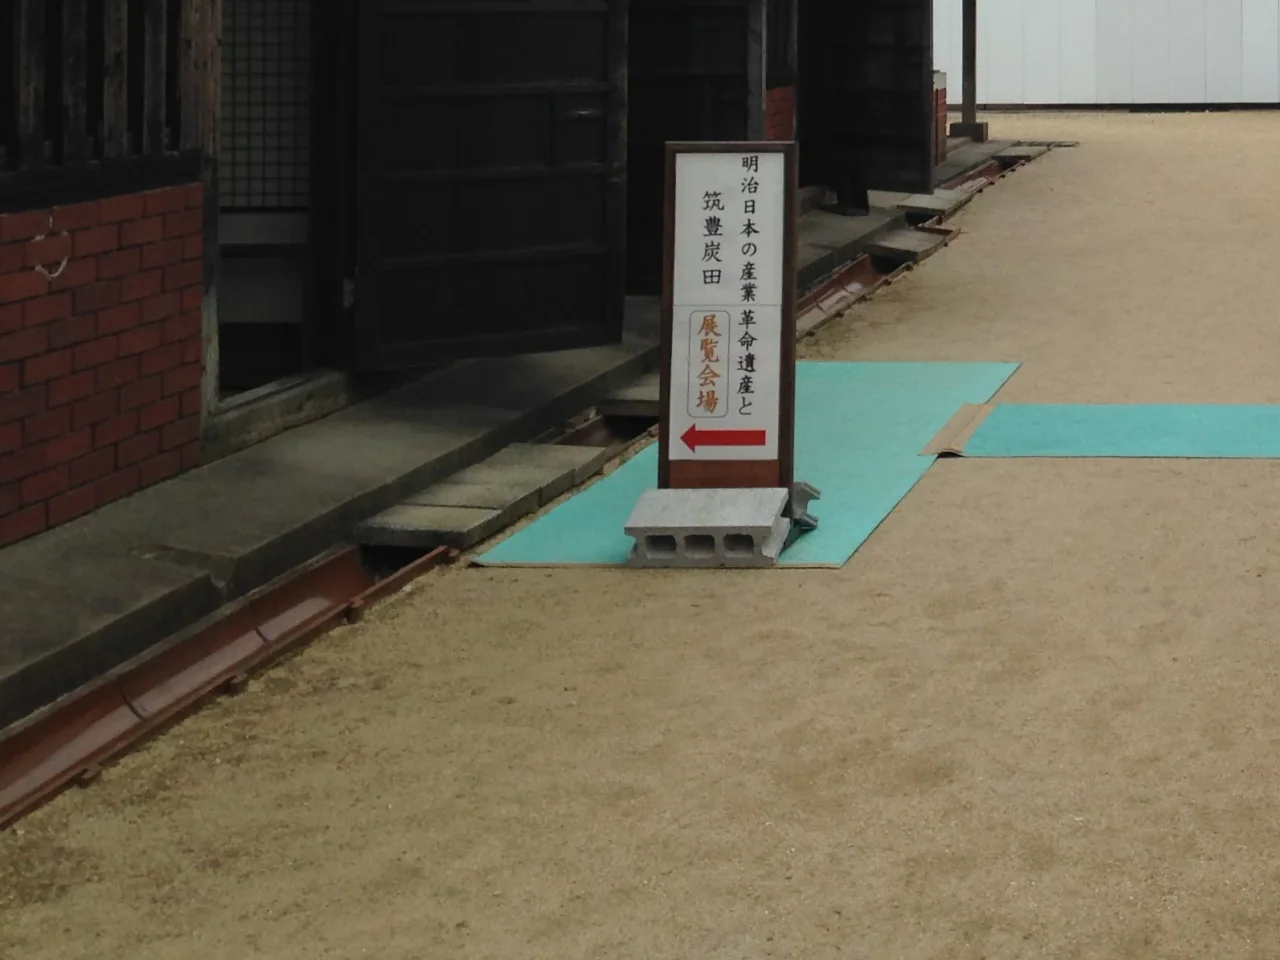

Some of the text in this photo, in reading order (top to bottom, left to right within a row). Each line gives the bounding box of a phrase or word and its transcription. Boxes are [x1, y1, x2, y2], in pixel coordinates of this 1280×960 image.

[702, 191, 725, 285] 筑豊炭田
[736, 155, 760, 416] 明治日本の産業革命遺産と
[696, 314, 722, 414] 展覧会場
